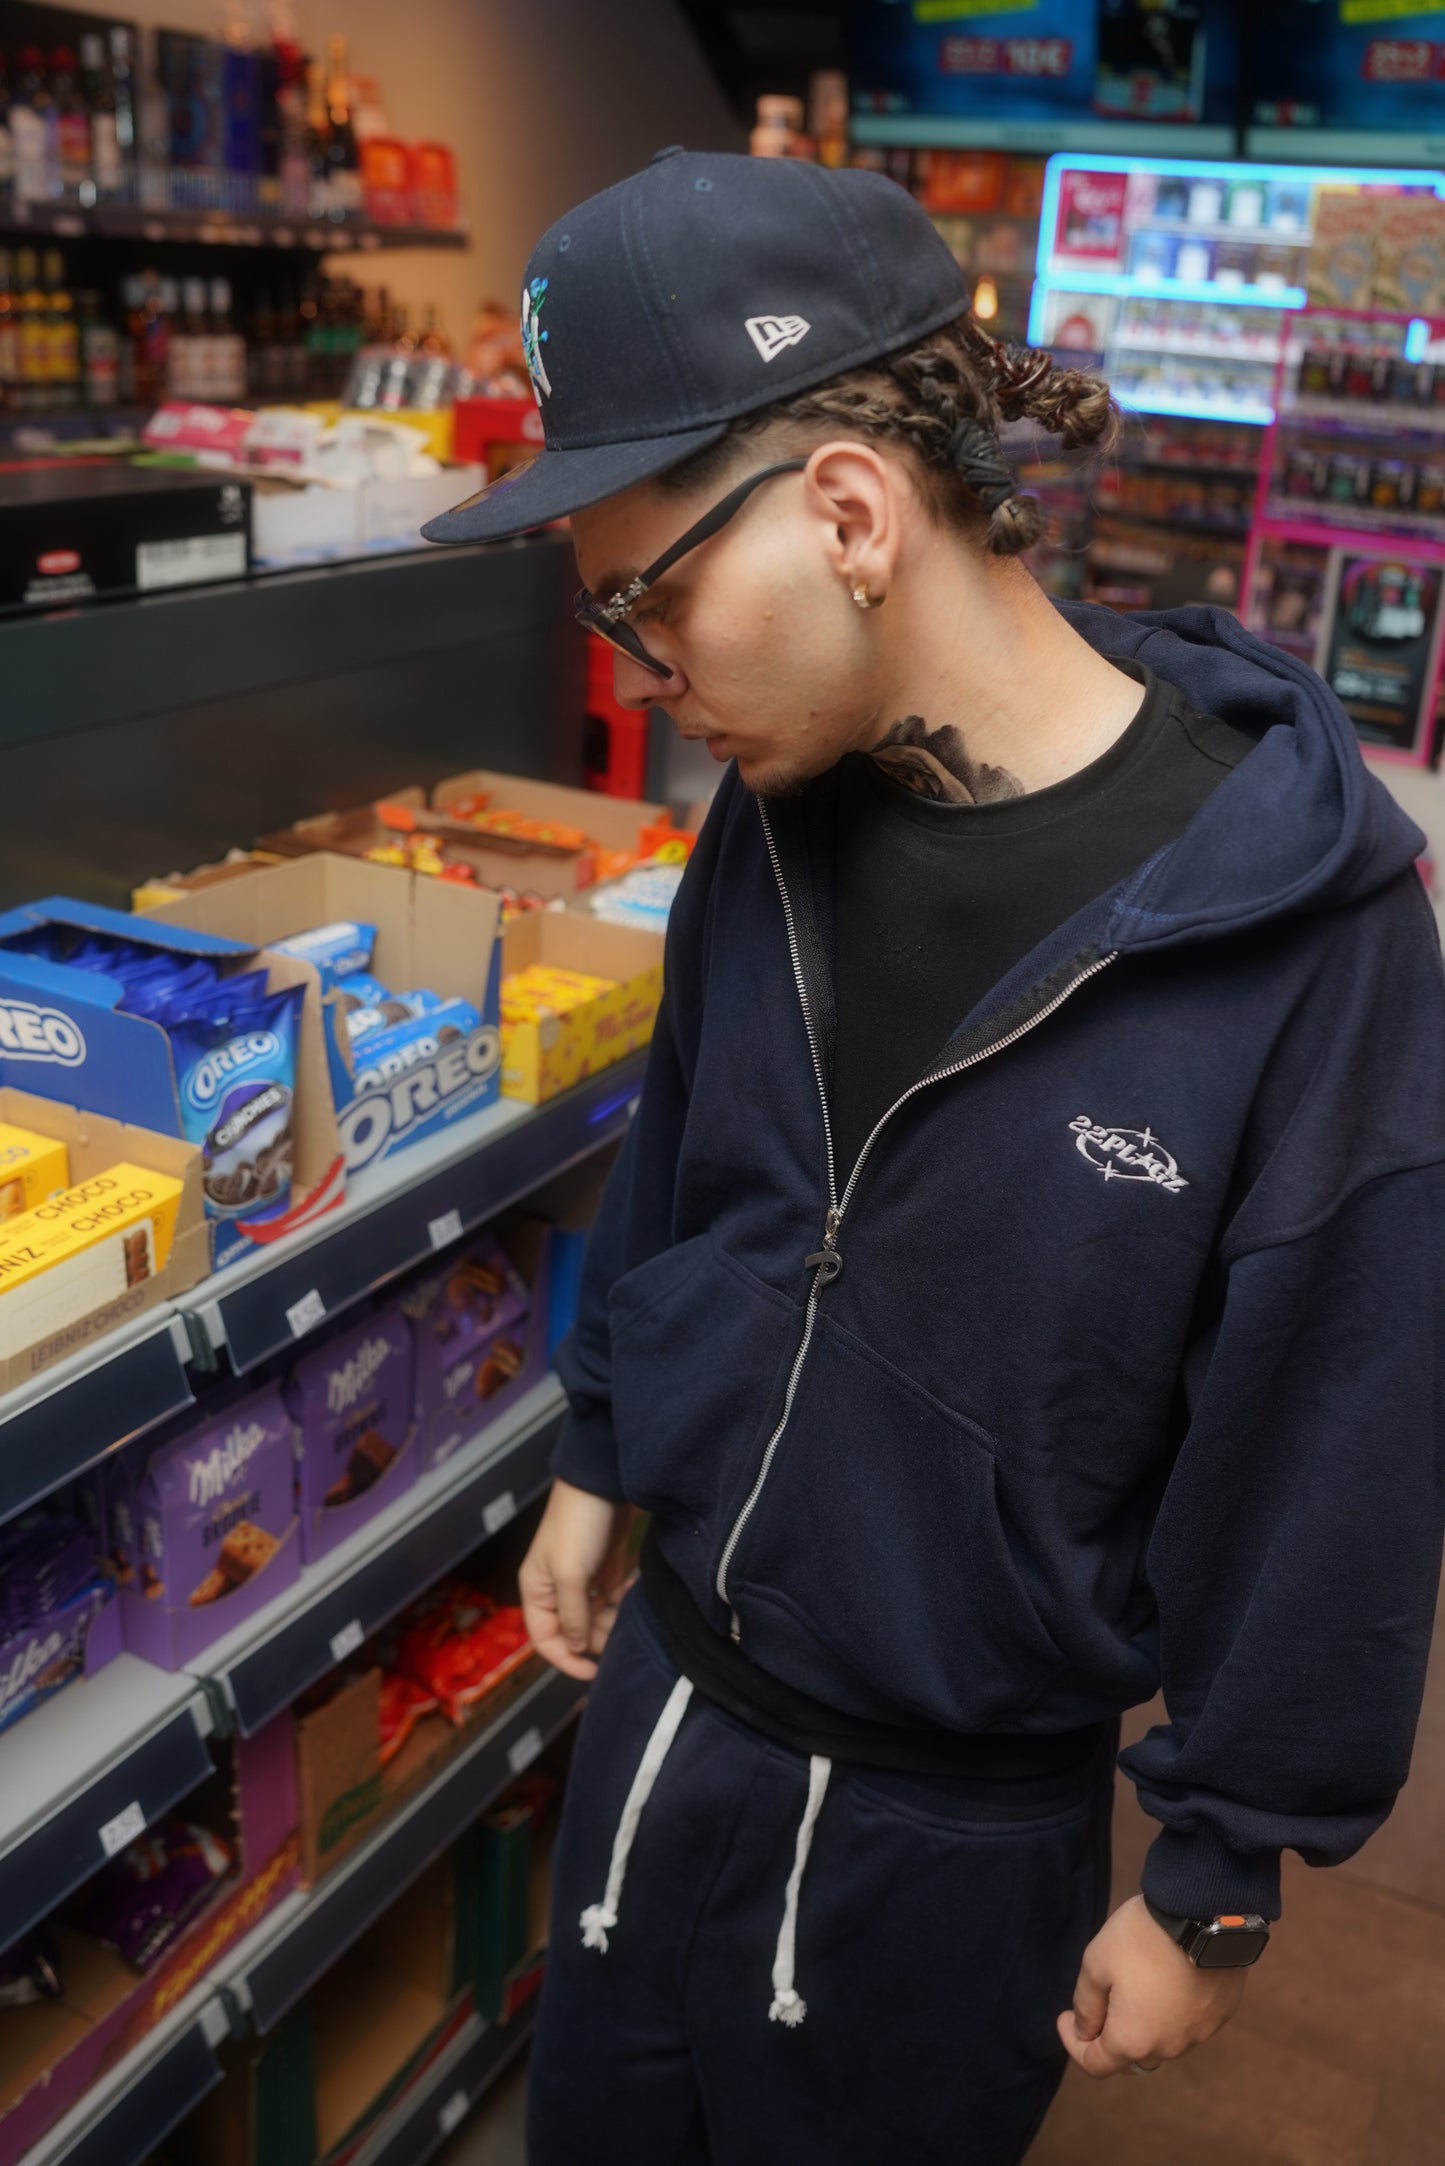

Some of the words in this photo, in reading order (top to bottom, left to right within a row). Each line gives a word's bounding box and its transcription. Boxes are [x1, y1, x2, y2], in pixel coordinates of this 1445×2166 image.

[195, 1036, 273, 1099] OREO
[338, 1033, 501, 1172] OREO
[35, 1178, 118, 1220] CHOCO
[71, 1189, 153, 1231] CHOCO
[30, 1318, 92, 1373] LEIBNIZ
[189, 1422, 267, 1507] Milka
